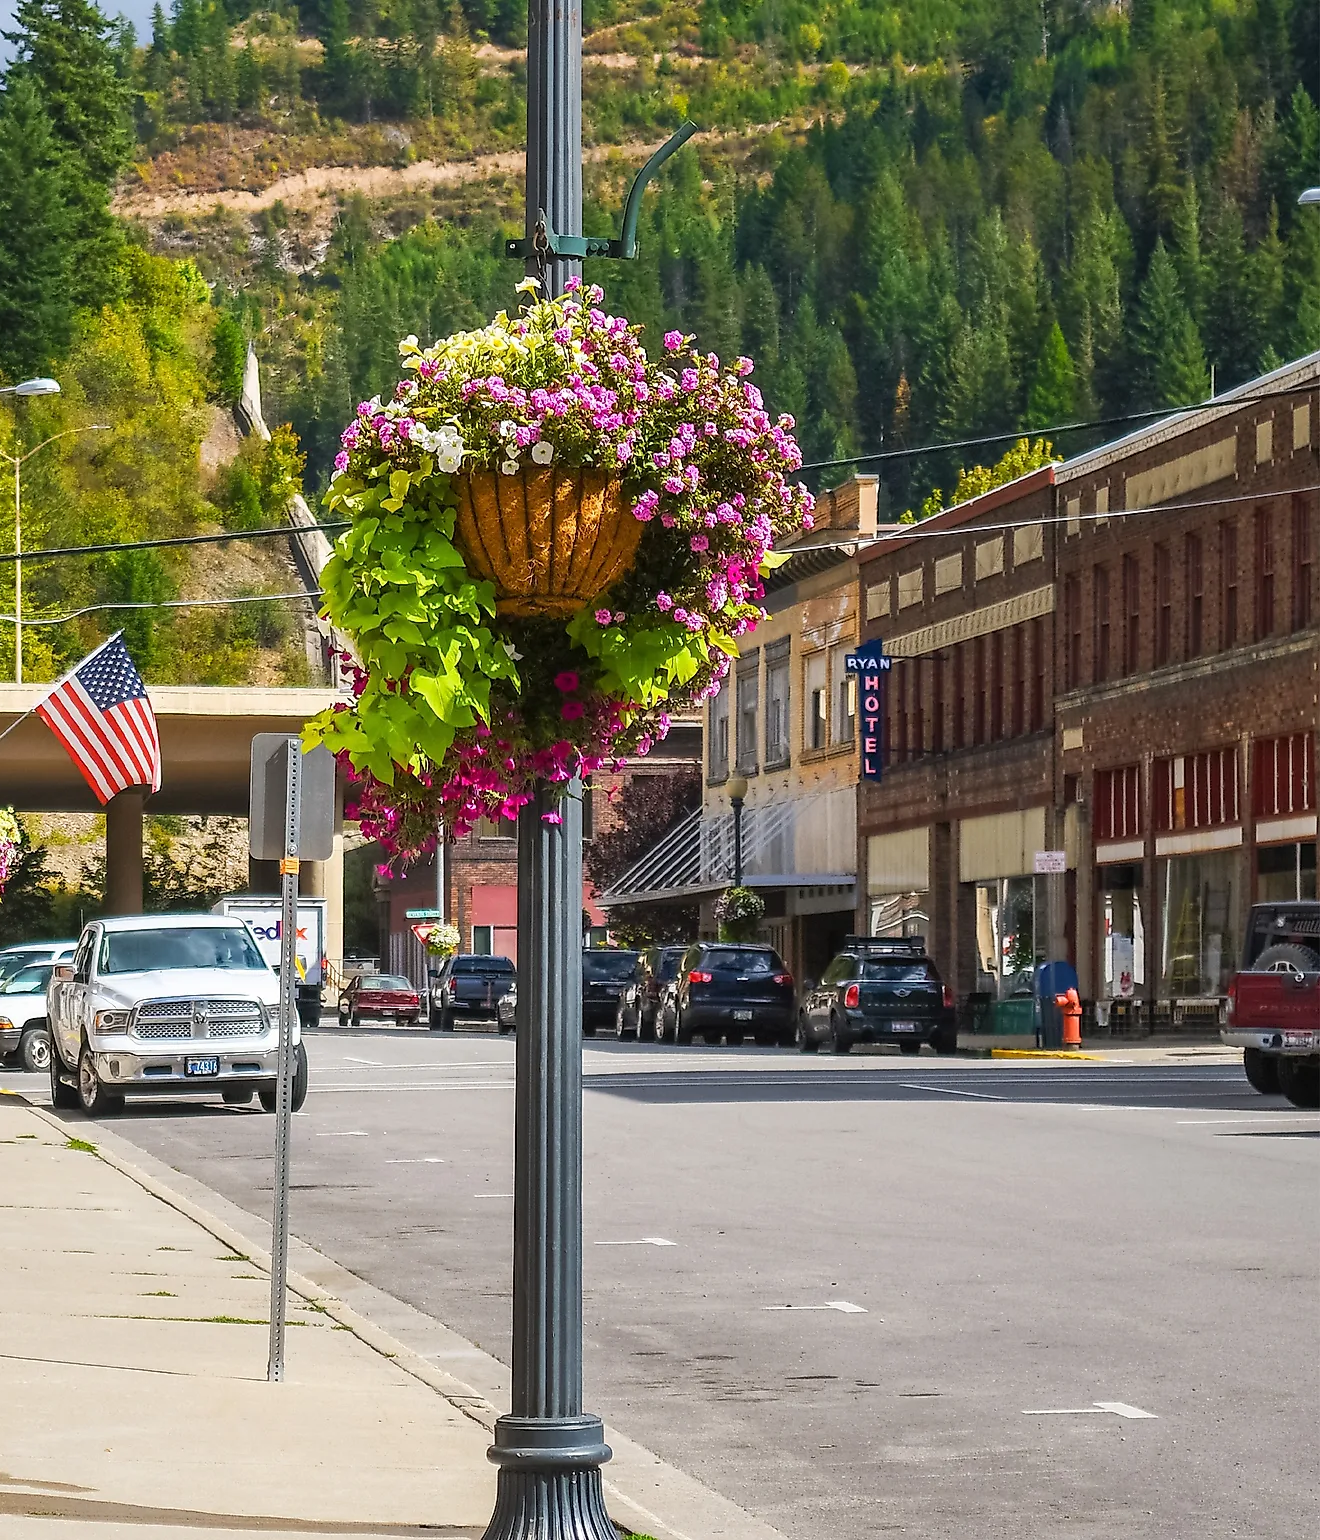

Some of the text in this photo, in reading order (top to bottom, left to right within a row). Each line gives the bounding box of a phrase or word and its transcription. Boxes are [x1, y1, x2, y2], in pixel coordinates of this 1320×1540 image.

[847, 657, 890, 670] RYAN
[864, 675, 880, 774] HOTEL
[245, 920, 308, 941] edx
